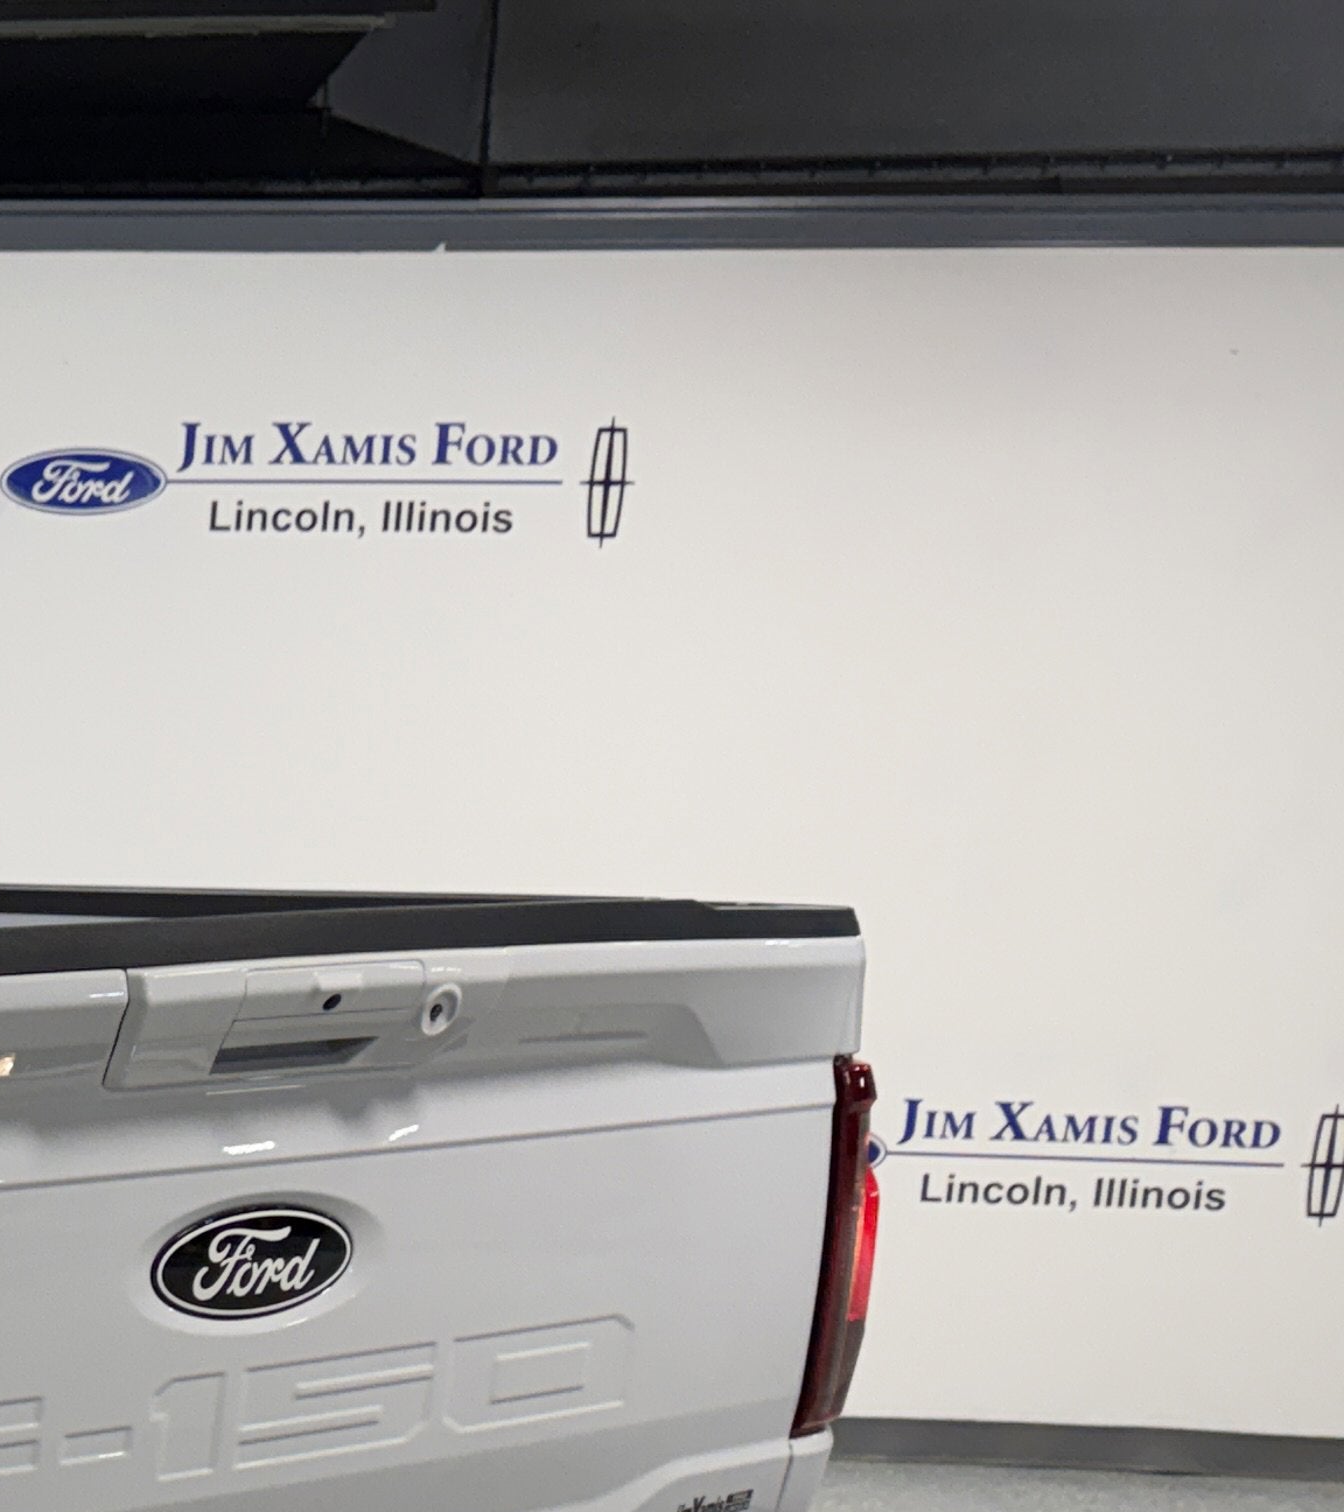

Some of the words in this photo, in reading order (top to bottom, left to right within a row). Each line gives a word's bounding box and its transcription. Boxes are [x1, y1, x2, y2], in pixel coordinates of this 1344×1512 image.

[177, 422, 254, 473] JIM
[269, 422, 416, 466] XAMIS
[432, 422, 558, 466] FORD
[31, 459, 134, 504] Ford
[209, 500, 365, 539] Lincoln,
[382, 501, 512, 534] Illinois
[897, 1099, 976, 1145] JIM
[989, 1101, 1138, 1146] XAMIS
[1153, 1106, 1281, 1149] FORD
[920, 1173, 1076, 1212] Lincoln,
[1094, 1178, 1225, 1211] Illinois
[192, 1226, 321, 1301] Ford
